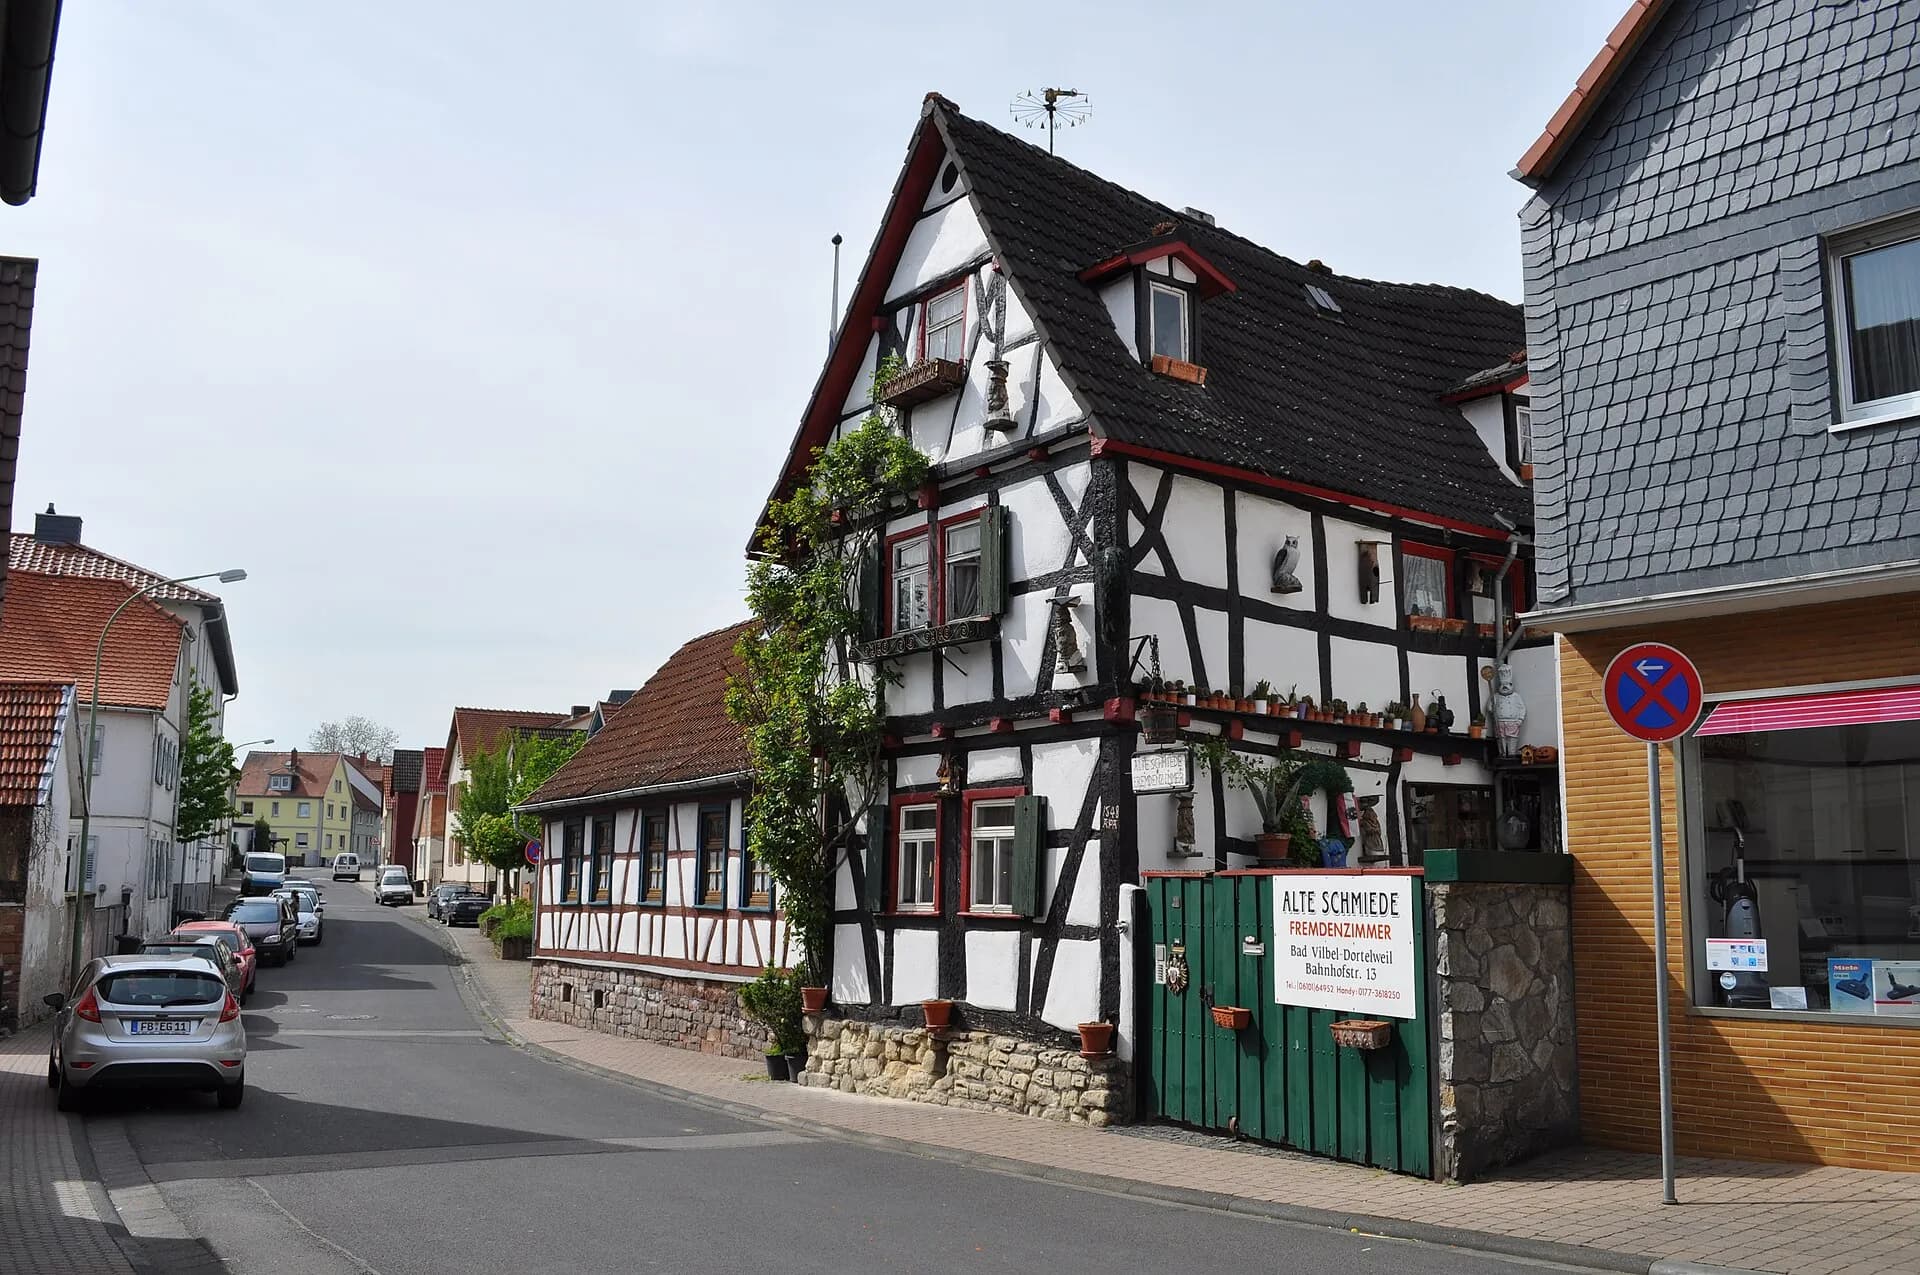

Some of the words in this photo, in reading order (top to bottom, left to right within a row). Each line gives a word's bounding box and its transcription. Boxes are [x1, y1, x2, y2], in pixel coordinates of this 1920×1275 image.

[1282, 890, 1316, 915] ALTE
[1321, 891, 1400, 918] SCHMIEDE
[1289, 921, 1391, 940] FREMDENZIMMER
[1290, 945, 1307, 957] Bad
[1311, 946, 1393, 964] Vilbel-Dortelweil
[1305, 962, 1362, 979] Bahnhofstr.
[1366, 968, 1377, 980] 13
[140, 1022, 154, 1031] FB
